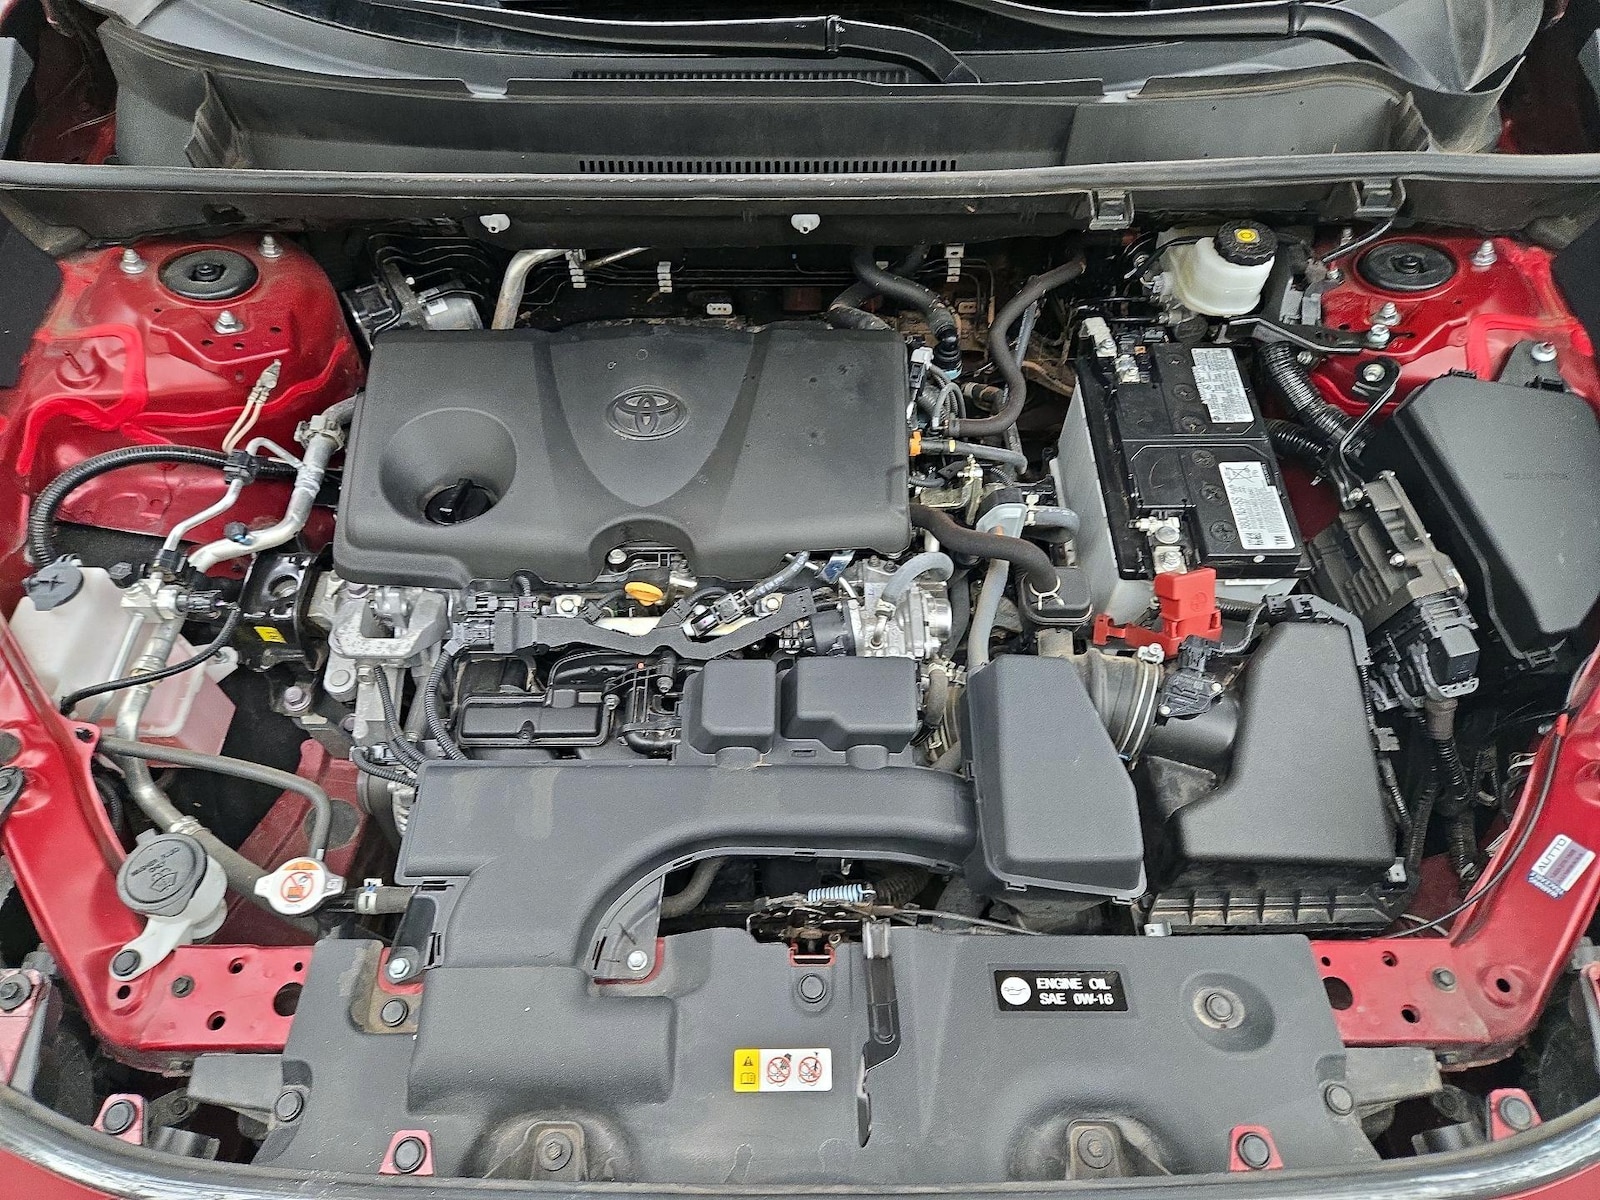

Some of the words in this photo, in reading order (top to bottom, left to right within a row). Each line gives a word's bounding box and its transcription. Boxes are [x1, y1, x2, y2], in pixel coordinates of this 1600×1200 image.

[1036, 978, 1083, 990] ENGINE
[1088, 978, 1112, 990] OIL
[1039, 993, 1067, 1005] SAE
[1072, 993, 1115, 1005] 0W-16
